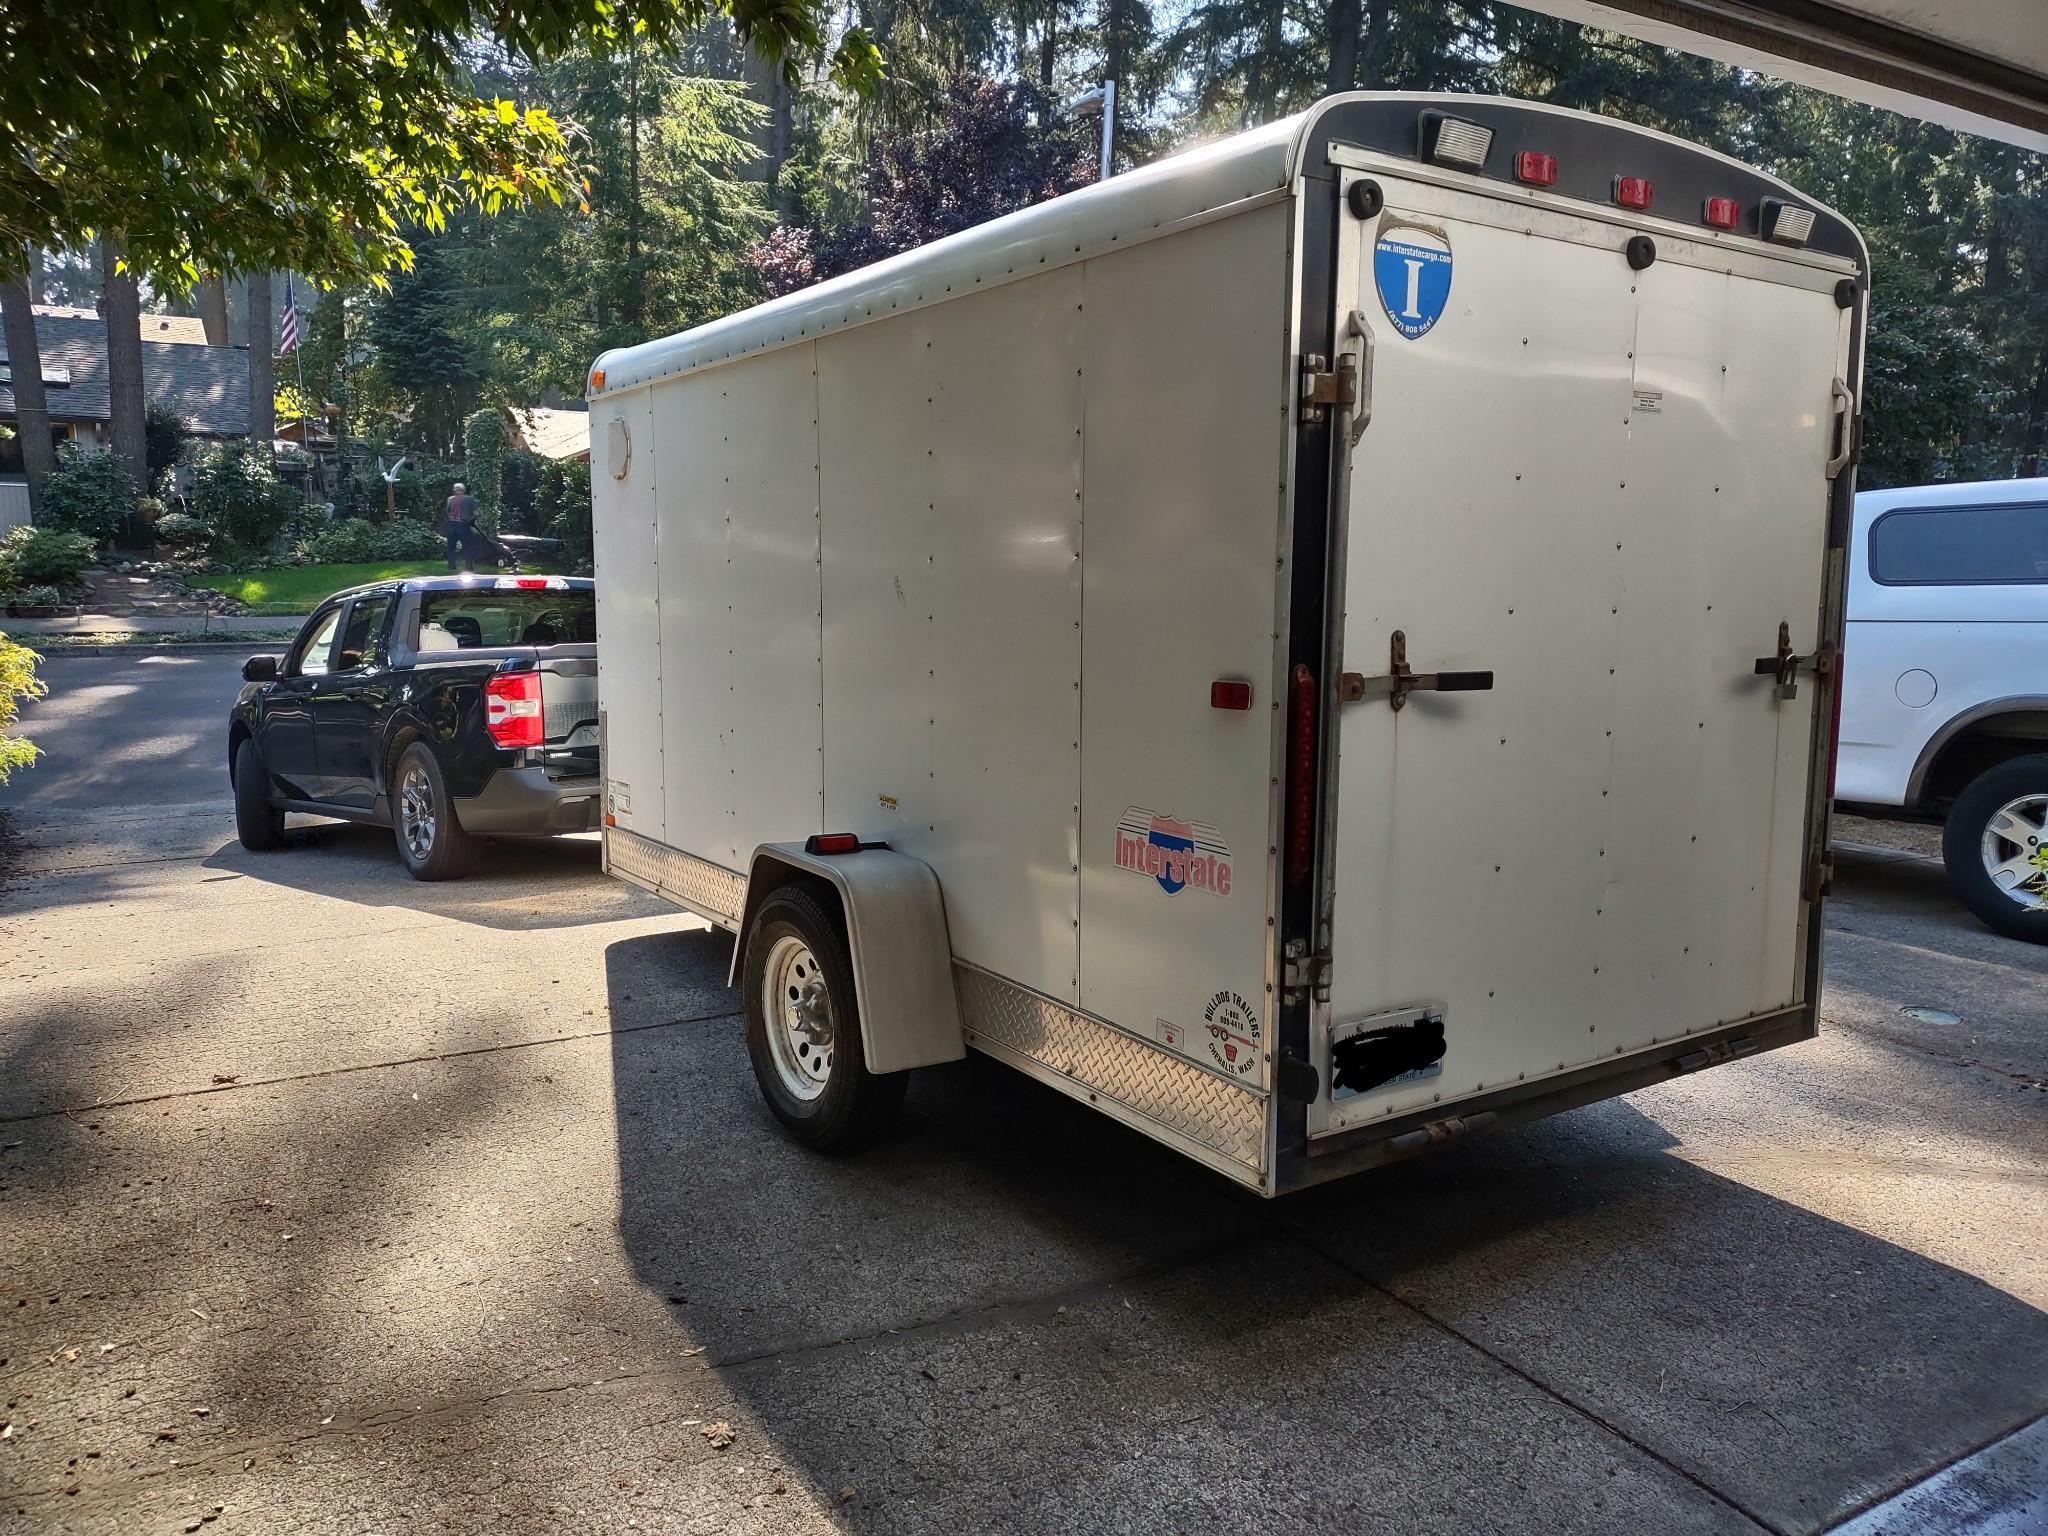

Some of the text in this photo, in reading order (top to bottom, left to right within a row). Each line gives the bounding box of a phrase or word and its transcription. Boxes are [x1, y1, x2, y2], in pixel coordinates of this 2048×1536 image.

[1402, 259, 1424, 318] I
[1116, 830, 1231, 896] Interstate
[1204, 991, 1261, 1039] BULLDOG TRAILERS
[1238, 1057, 1255, 1074] WASH
